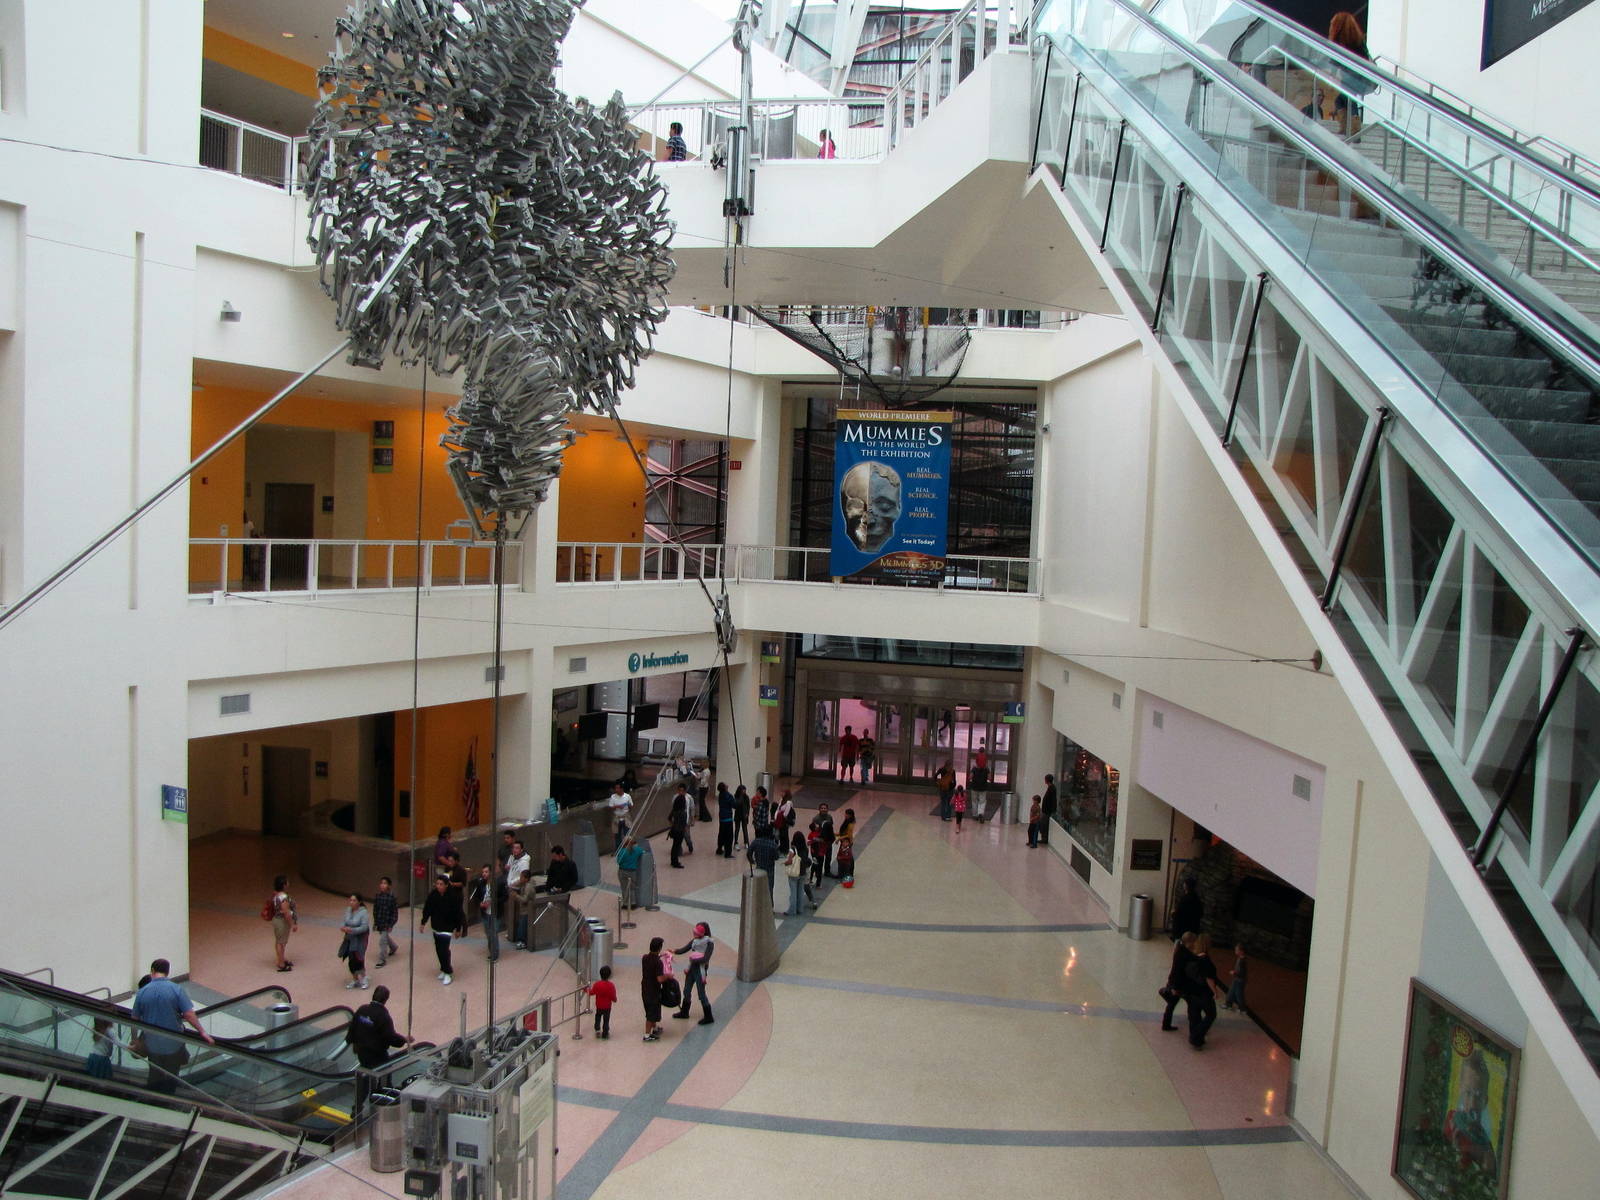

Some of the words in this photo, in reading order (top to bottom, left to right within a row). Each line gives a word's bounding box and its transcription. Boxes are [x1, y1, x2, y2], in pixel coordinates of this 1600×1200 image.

[858, 411, 889, 419] WORLD
[890, 412, 930, 420] PREMIERE
[844, 423, 943, 446] MUMMIES
[896, 441, 926, 449] WORLD
[861, 449, 878, 457] THE
[880, 449, 931, 459] EXHIBITION
[918, 538, 936, 546] Today!
[929, 560, 945, 571] 3D
[643, 651, 688, 668] Information
